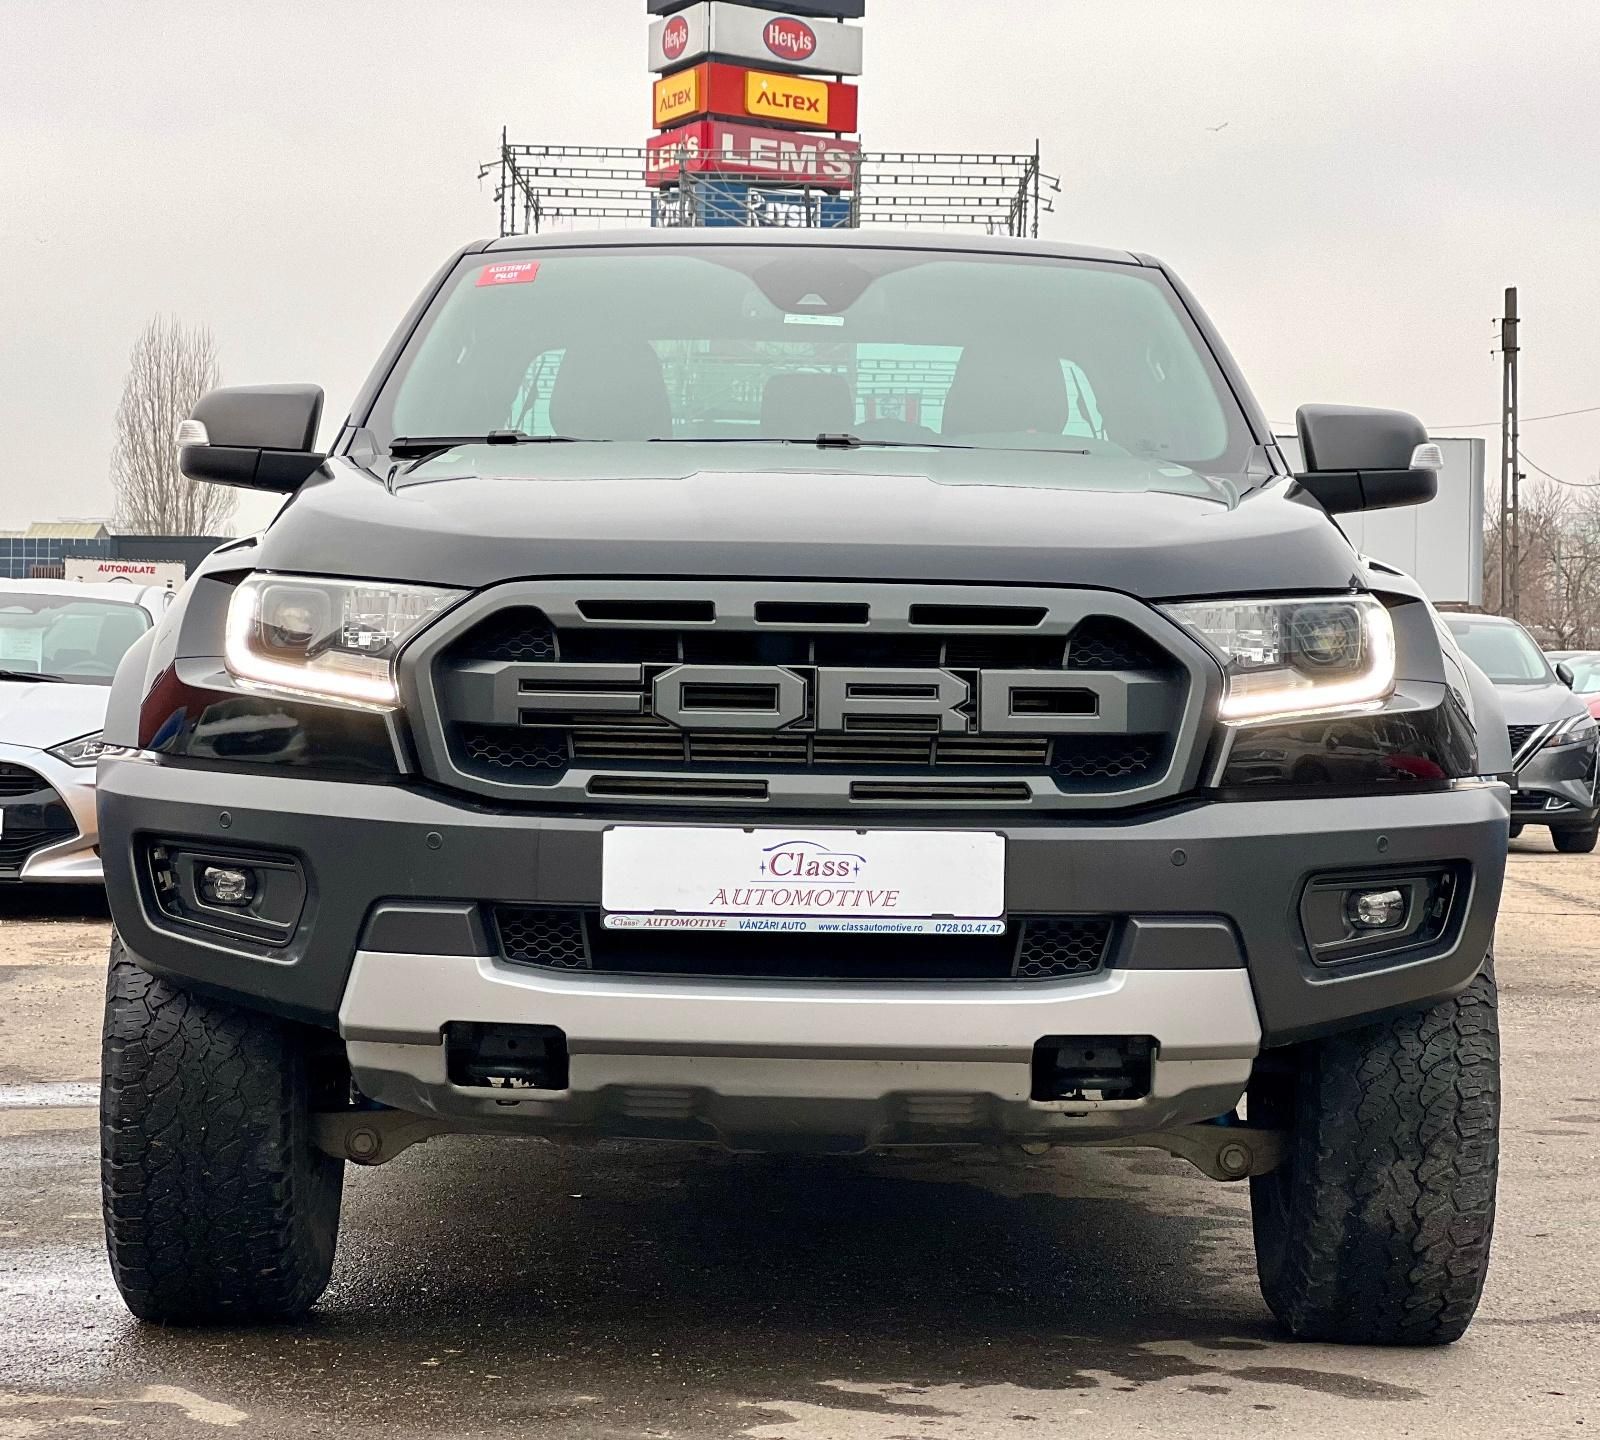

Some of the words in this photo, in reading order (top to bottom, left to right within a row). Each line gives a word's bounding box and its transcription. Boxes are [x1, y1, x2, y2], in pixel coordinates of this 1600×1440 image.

[665, 25, 687, 49] Hervis
[769, 24, 812, 52] Hervis
[494, 271, 518, 280] PILOT
[98, 564, 156, 574] AUTORULATE
[493, 662, 1128, 734] FORD
[769, 852, 850, 877] Class
[708, 888, 900, 907] AUTOMOTIVE
[613, 918, 637, 927] Class
[643, 918, 727, 928] AUTOMOTIVE
[781, 920, 807, 931] AUTO
[818, 922, 924, 933] www.classautomotive.ro
[935, 923, 1002, 934] 0728.03.47.47
